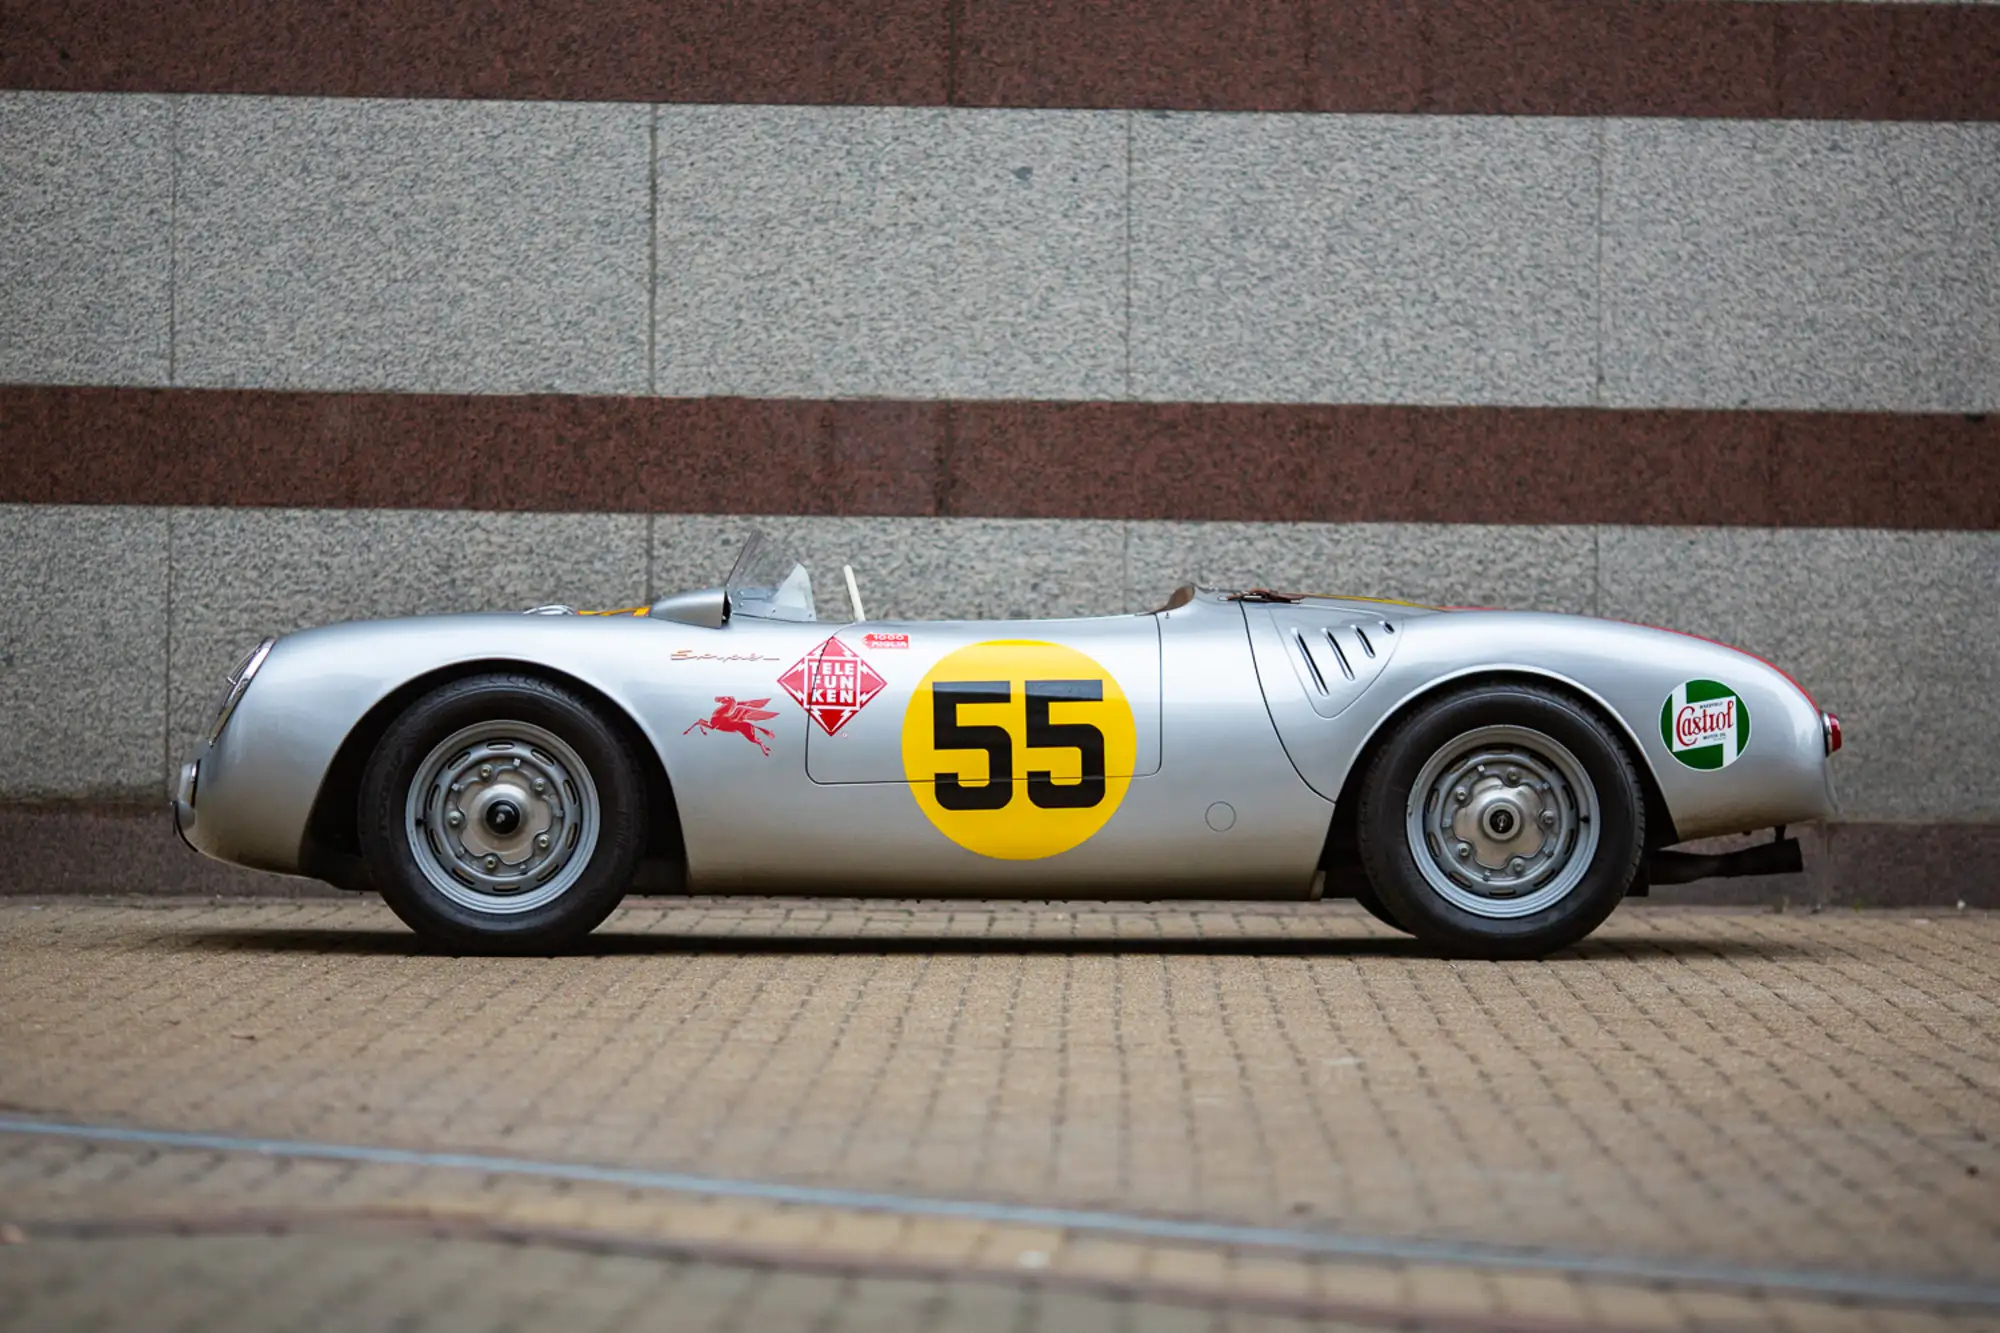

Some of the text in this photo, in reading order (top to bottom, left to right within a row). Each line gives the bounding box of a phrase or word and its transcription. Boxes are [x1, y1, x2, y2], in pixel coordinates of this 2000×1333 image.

[809, 662, 855, 675] TELE
[812, 676, 854, 689] FUN
[812, 689, 854, 703] KEN
[1676, 700, 1734, 747] Castrol
[933, 679, 1106, 811] 55
